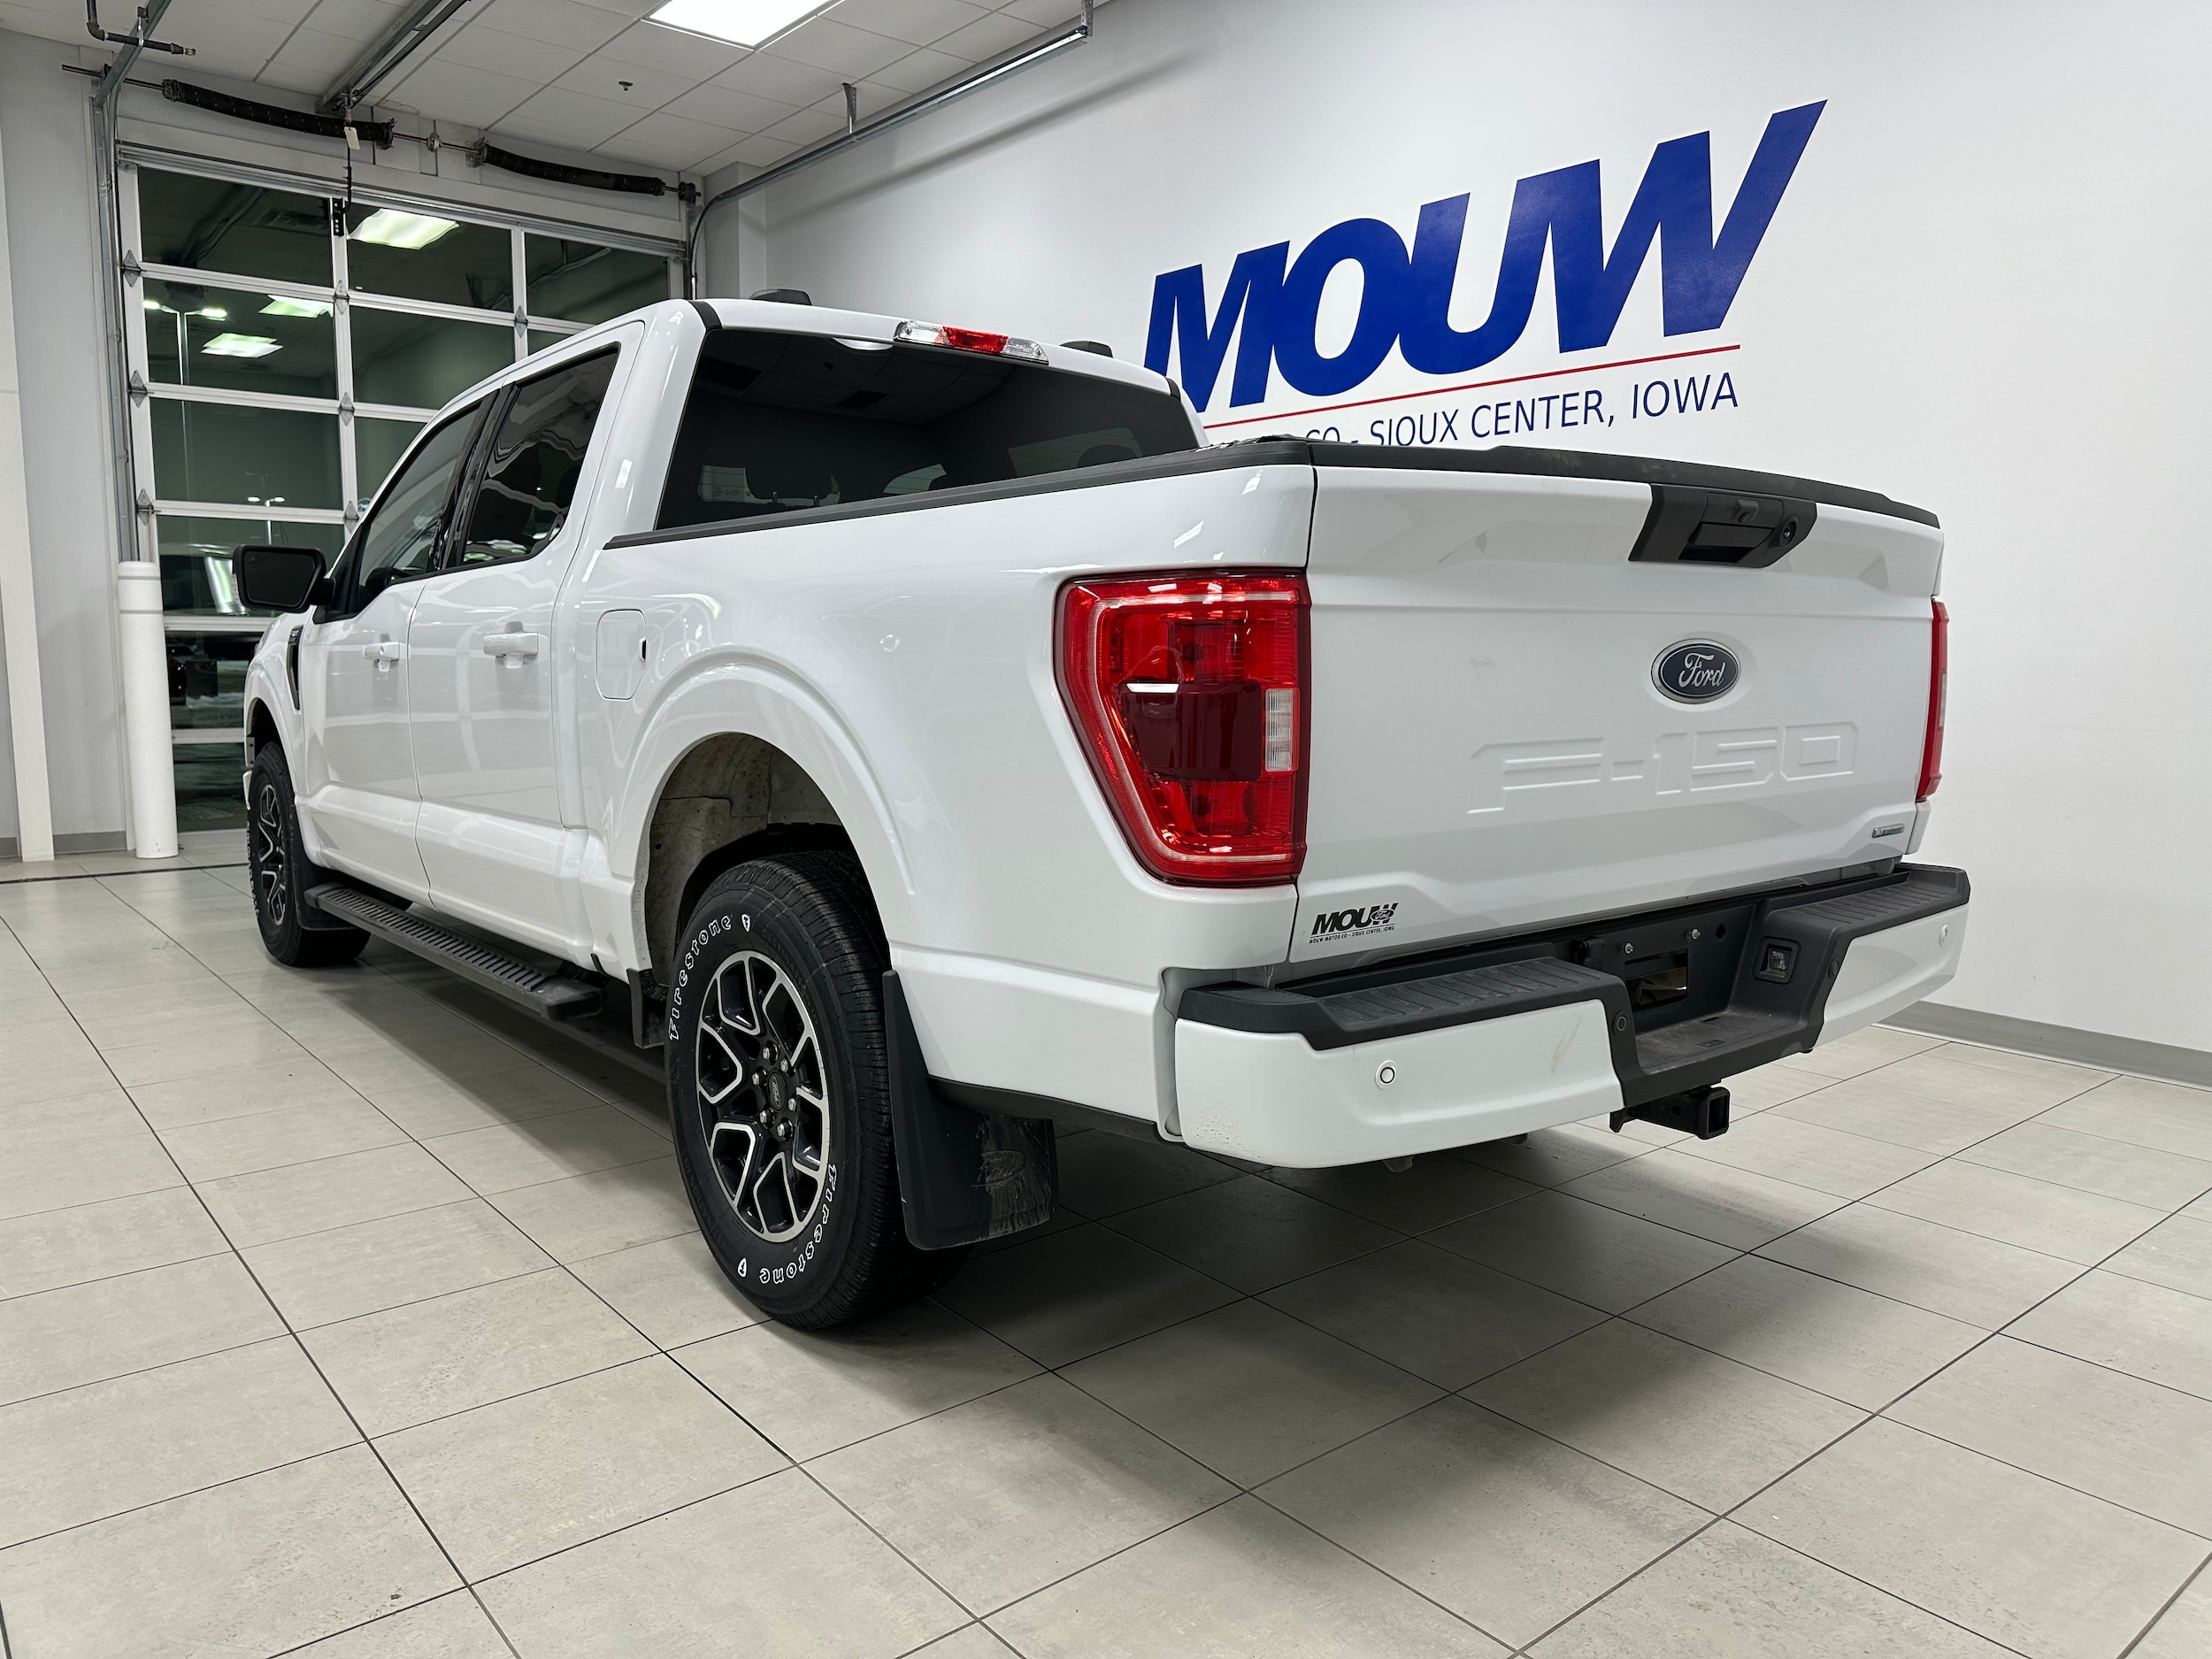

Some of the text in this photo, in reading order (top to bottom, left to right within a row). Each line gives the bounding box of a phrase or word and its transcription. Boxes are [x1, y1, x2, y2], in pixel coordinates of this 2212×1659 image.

[1143, 99, 1828, 413] MOUW
[1371, 409, 1459, 446] SIOUX
[1471, 389, 1615, 439] CENTER,
[1632, 372, 1739, 419] IOWA
[1678, 652, 1726, 687] Ford
[1467, 721, 1857, 815] F-150
[1310, 902, 1399, 935] MOUW
[668, 914, 732, 1041] Firestone
[759, 1164, 837, 1285] Firestone
